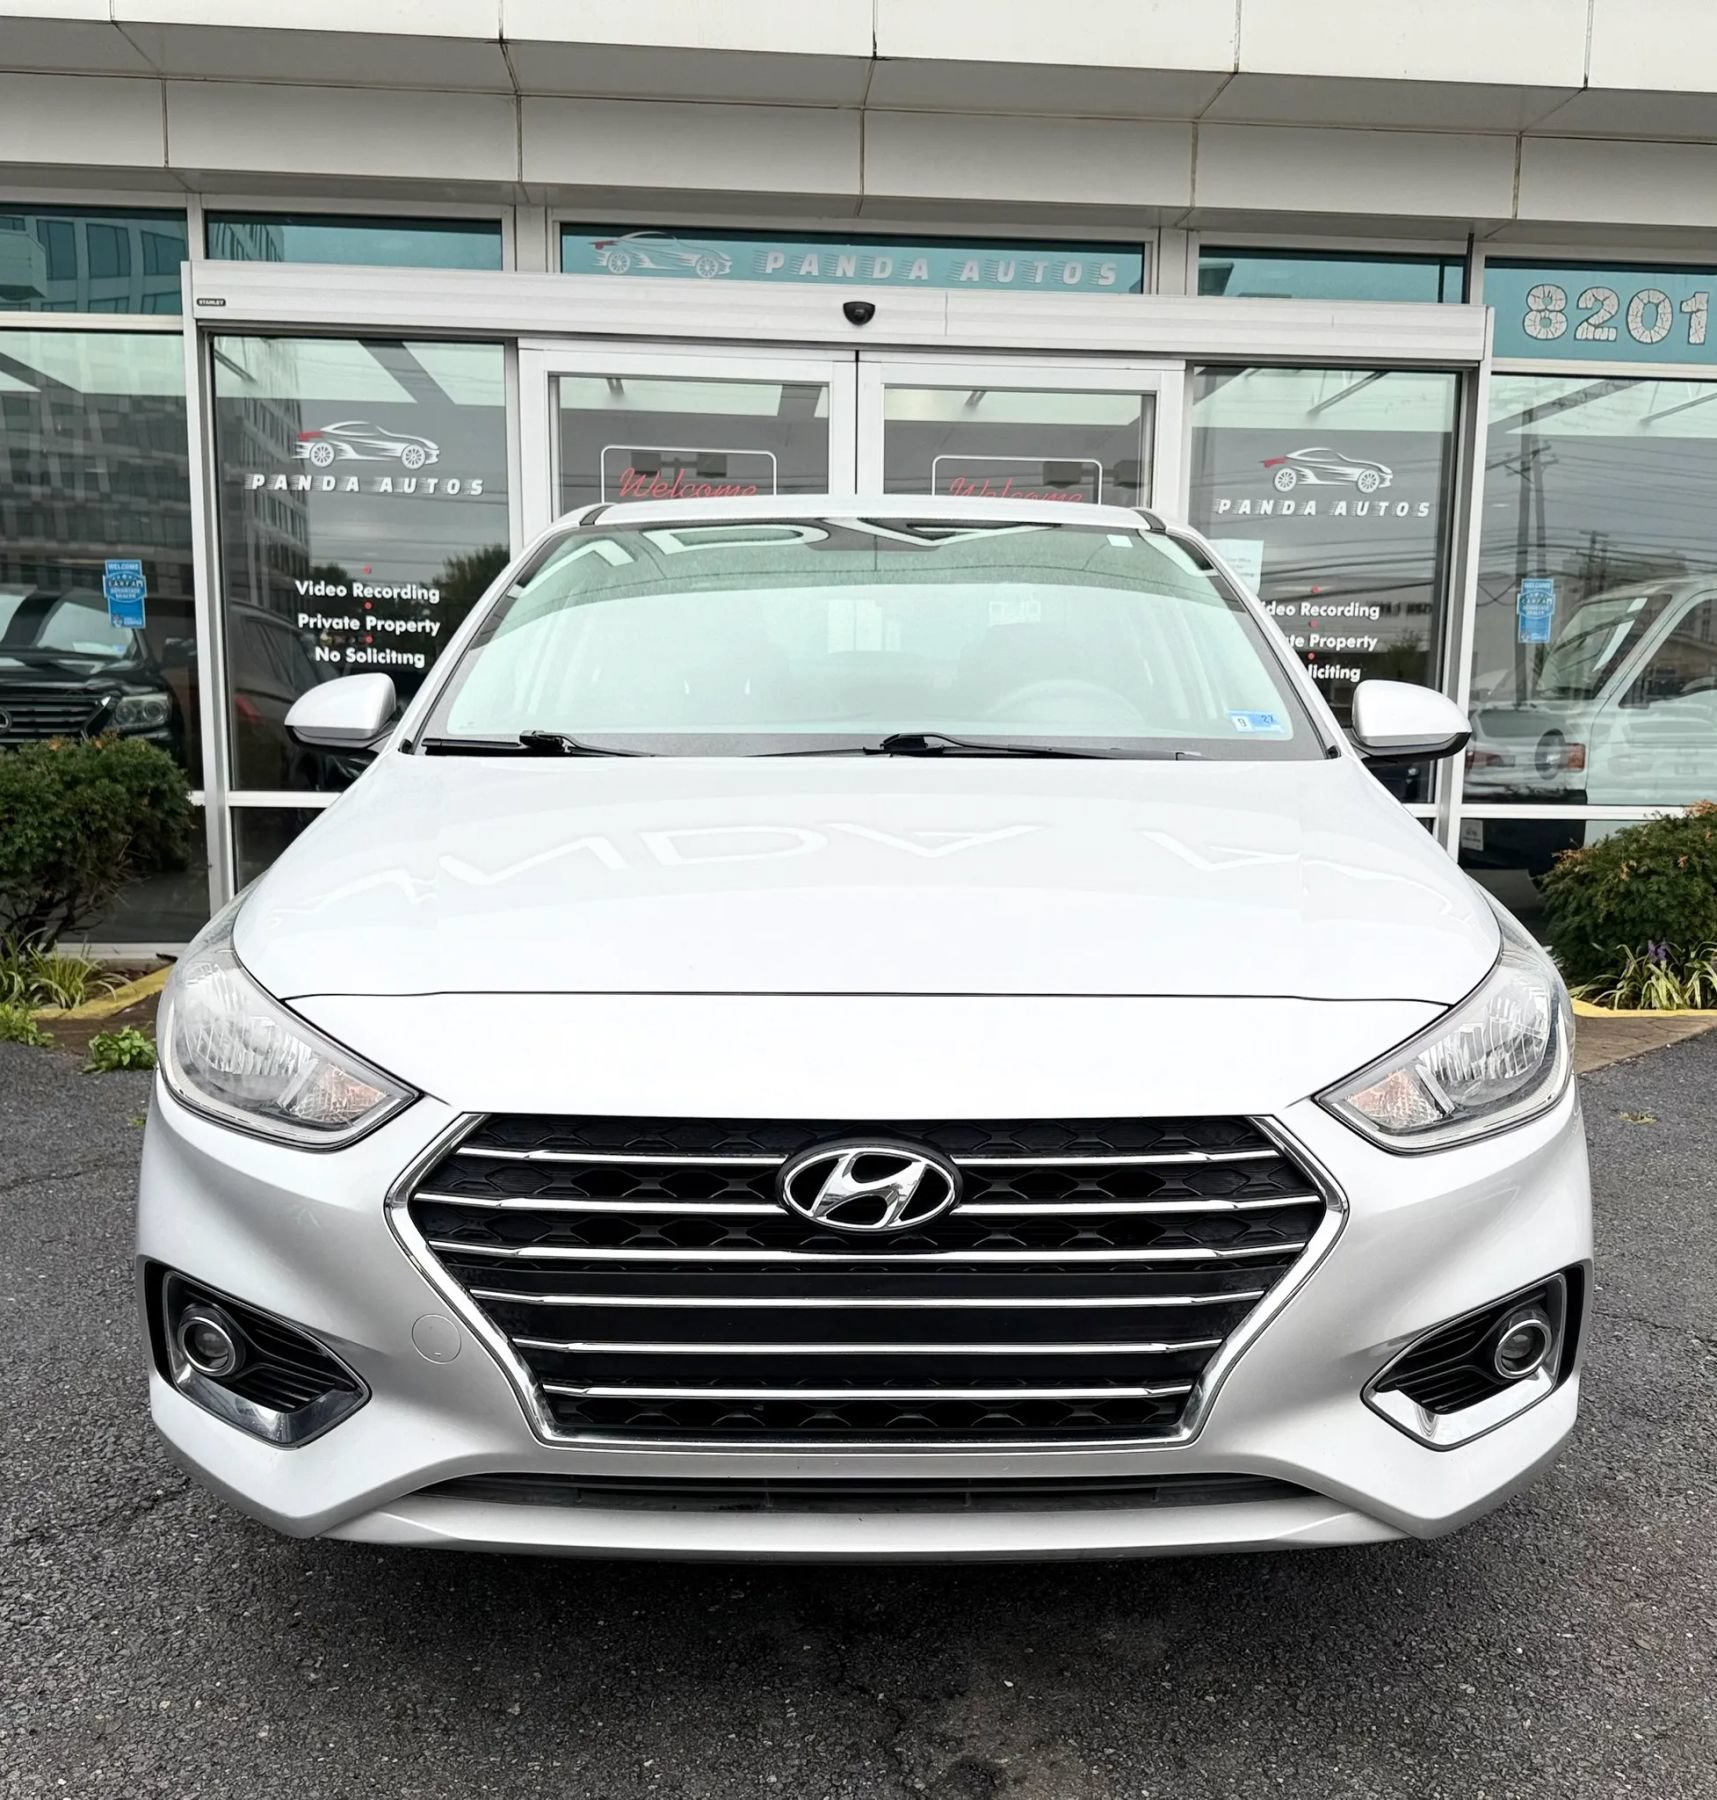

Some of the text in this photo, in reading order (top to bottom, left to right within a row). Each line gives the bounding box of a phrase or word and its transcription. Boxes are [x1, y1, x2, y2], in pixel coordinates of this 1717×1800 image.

[758, 252, 1118, 286] PANDA AUTOS
[1522, 284, 1710, 346] 8201
[247, 474, 484, 496] PANDA AUTOS
[619, 467, 758, 498] Welcome
[1215, 500, 1431, 516] PANDA AUTOS
[295, 580, 441, 604] Video Recording
[1261, 600, 1296, 616] ideo
[1300, 602, 1380, 620] Recording
[297, 613, 441, 637] Private Property
[1309, 634, 1378, 651] Property
[315, 647, 426, 668] No Soliciting
[1307, 664, 1361, 682] liciting
